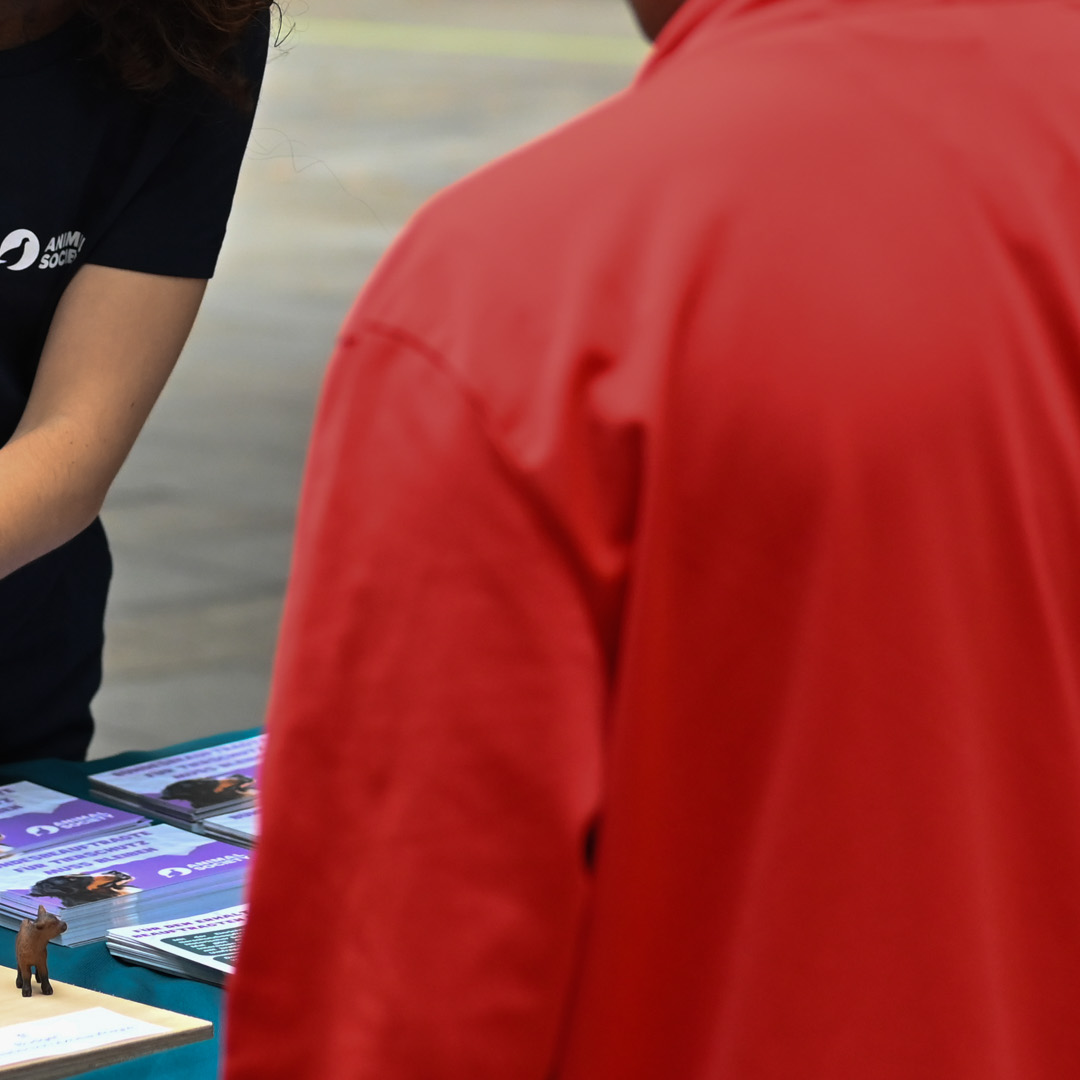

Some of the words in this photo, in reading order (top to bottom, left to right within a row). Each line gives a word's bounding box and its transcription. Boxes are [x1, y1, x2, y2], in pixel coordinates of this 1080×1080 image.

[10, 862, 49, 873] FÜR
[48, 840, 151, 865] TIERSCHUTZ
[42, 861, 94, 875] MUSS
